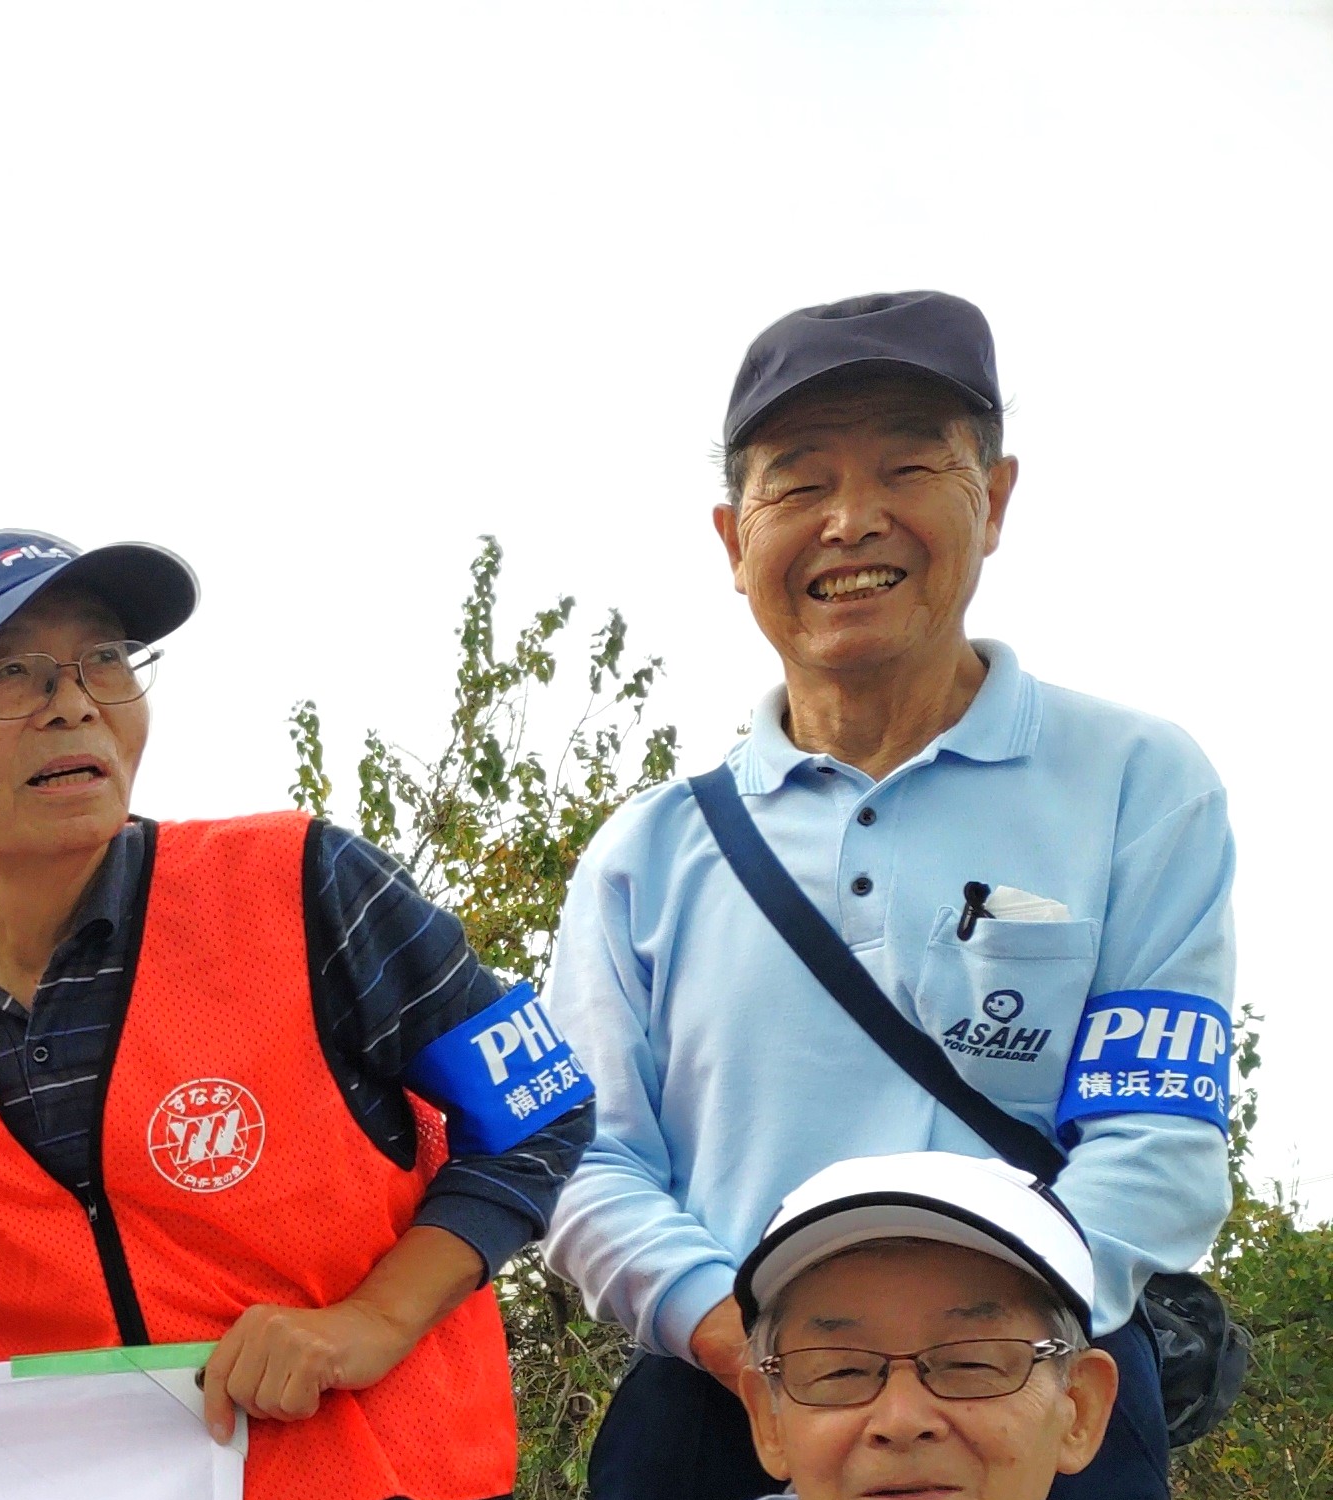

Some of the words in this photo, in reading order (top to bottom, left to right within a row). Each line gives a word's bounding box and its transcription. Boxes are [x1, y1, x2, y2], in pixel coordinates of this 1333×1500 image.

[943, 1018, 1052, 1052] ASAHI
[943, 1038, 984, 1057] YOUTH
[985, 1048, 1039, 1063] LEADER
[1079, 1006, 1226, 1065] PHP
[168, 1085, 232, 1114] すなお
